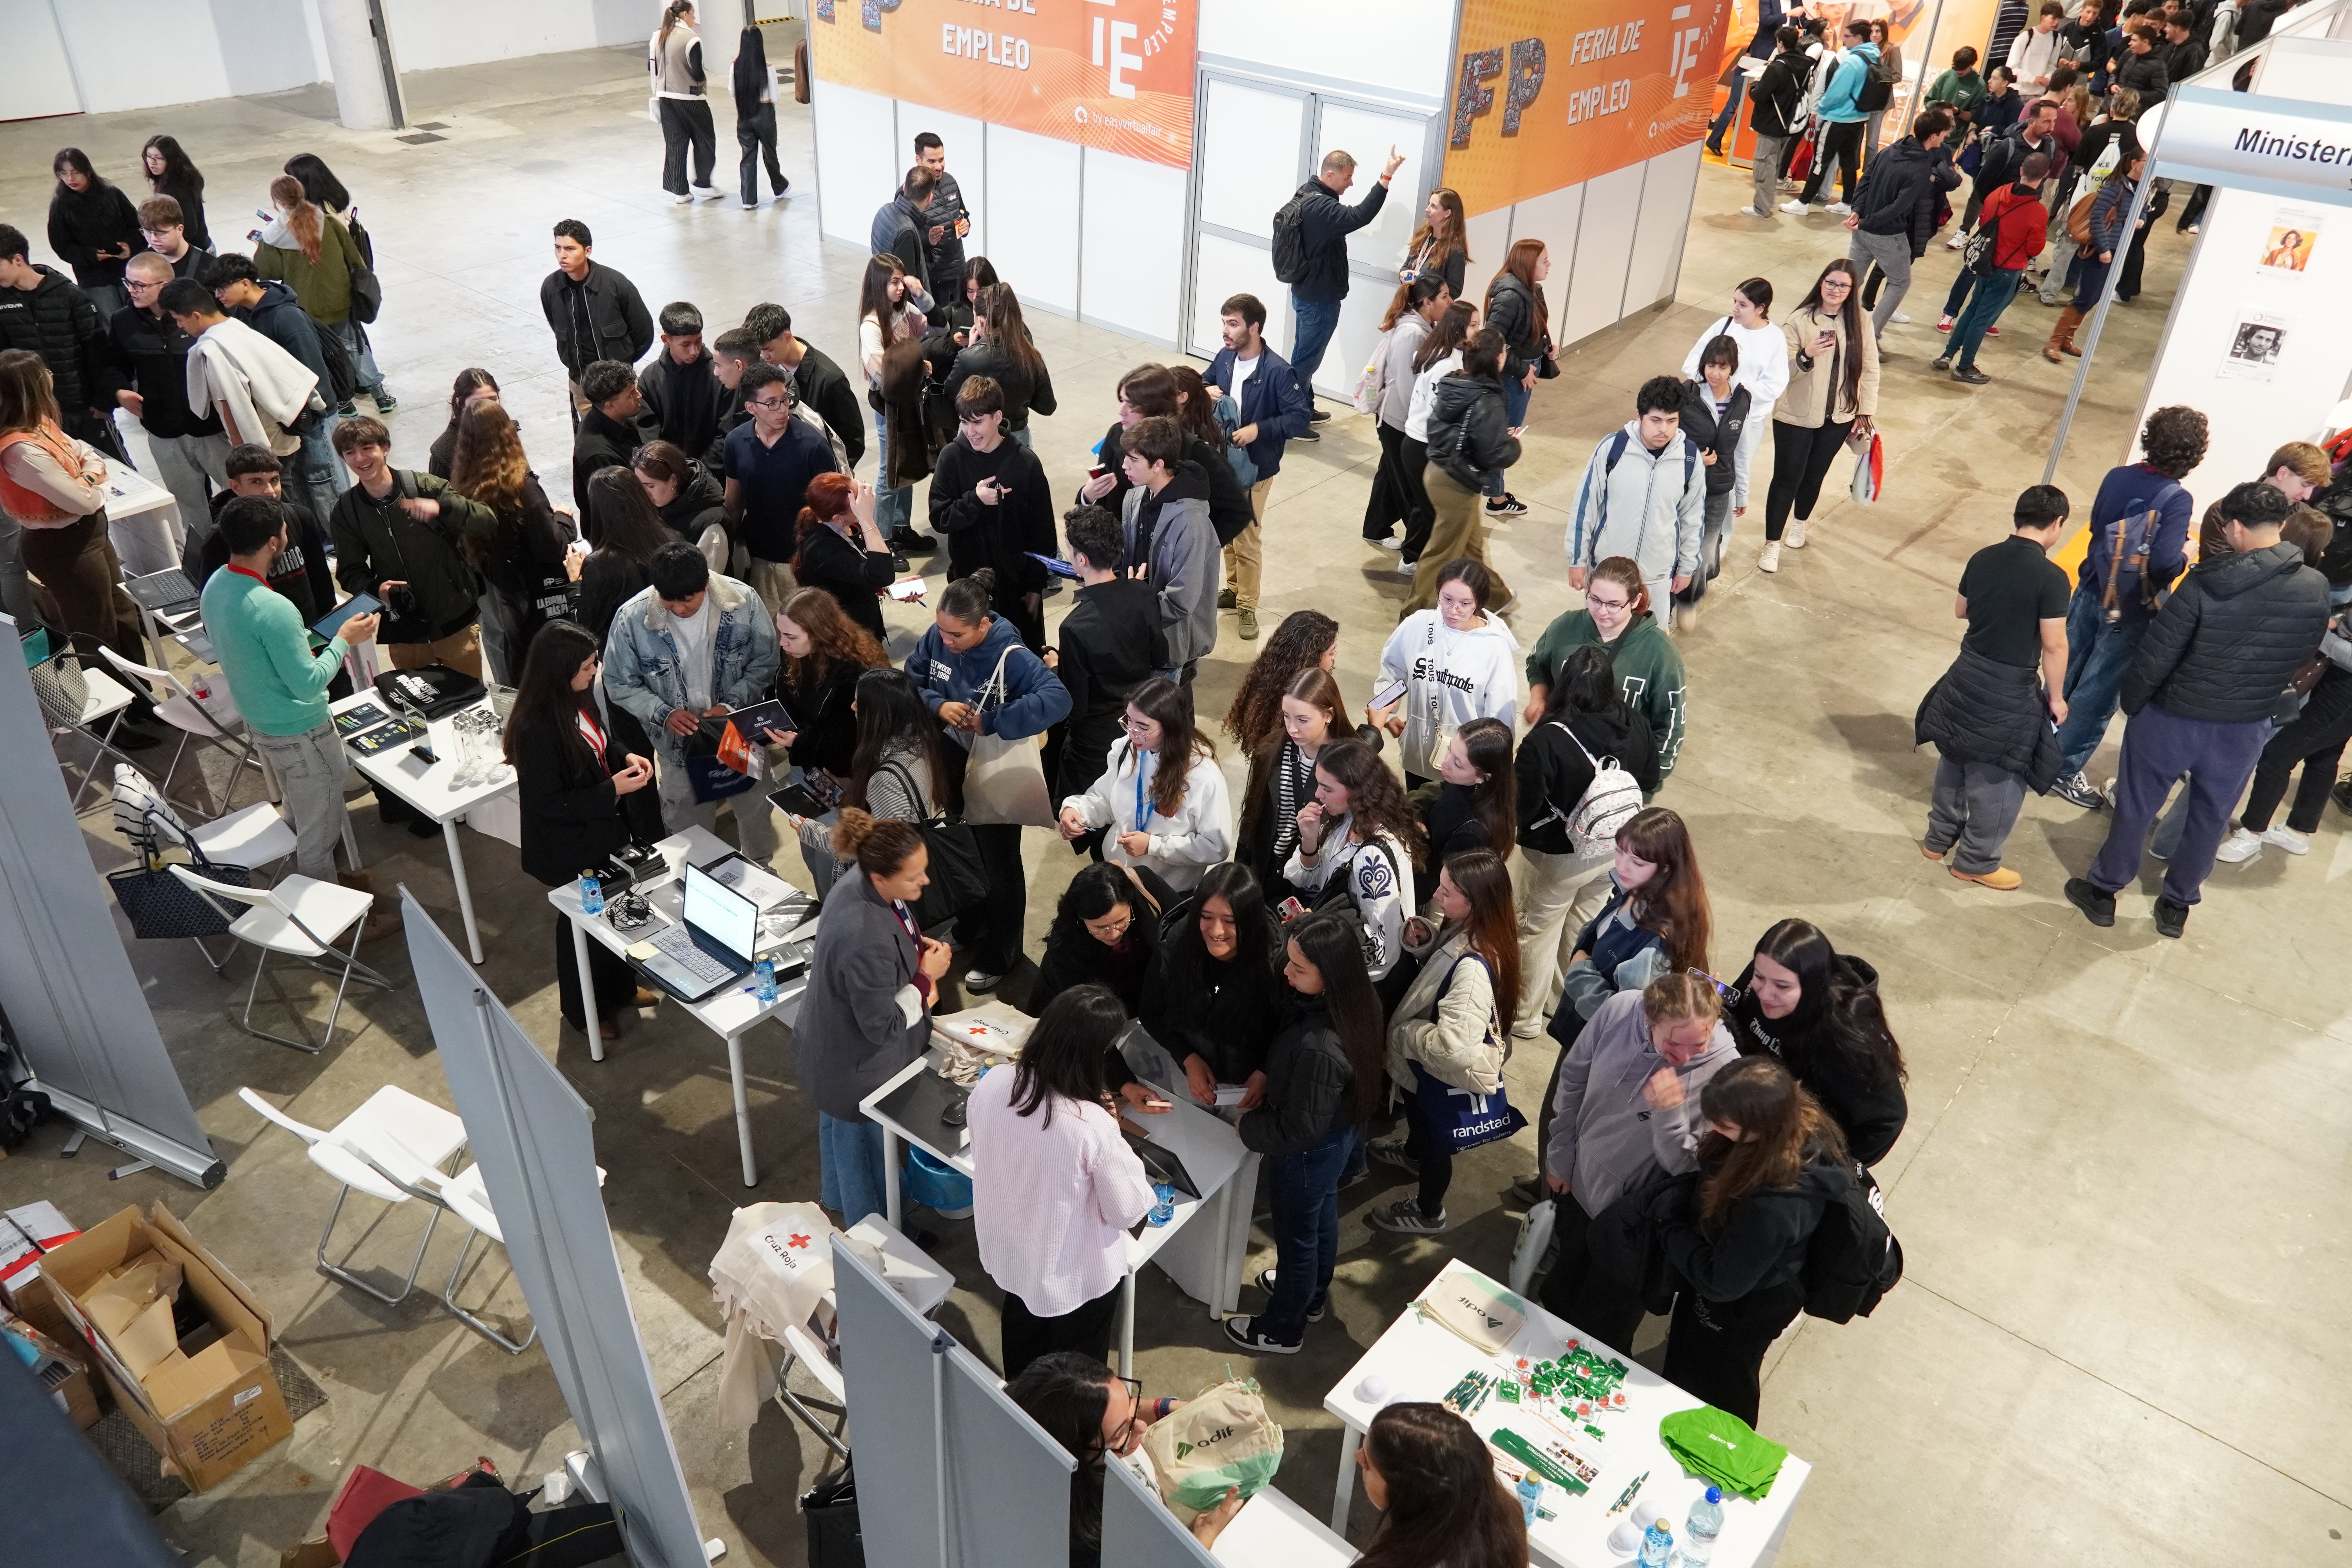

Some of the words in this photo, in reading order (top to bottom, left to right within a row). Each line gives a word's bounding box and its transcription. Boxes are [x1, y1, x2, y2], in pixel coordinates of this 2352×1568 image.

[1700, 0, 1722, 51] MPLEO
[943, 24, 1030, 71] EMPLEO
[1571, 25, 1619, 66] FERIA
[1621, 20, 1645, 54] DE
[1450, 37, 1546, 150] FP
[1568, 78, 1631, 126] EMPLEO
[1093, 111, 1102, 126] by
[1105, 116, 1162, 137] easyvirtualfair
[545, 594, 568, 608] FORMA
[931, 659, 952, 675] LLYWOOD
[1413, 657, 1474, 693] Suthpole
[754, 719, 772, 728] OKUANT
[811, 772, 820, 782] 10:39
[628, 848, 642, 857] OKUANT
[775, 952, 785, 962] OKUANT
[991, 1026, 1009, 1035] Cruz
[1453, 1112, 1511, 1138] randstad
[1456, 1140, 1481, 1152] partner
[765, 1235, 782, 1253] Cruz
[780, 1251, 796, 1269] Roja
[1456, 1296, 1486, 1316] adif
[1197, 1425, 1234, 1447] adif
[1708, 1433, 1726, 1444] adif
[1526, 1445, 1548, 1463] NOSOTROS
[1548, 1460, 1557, 1469] CON
[1557, 1466, 1574, 1482] TRABAJA
